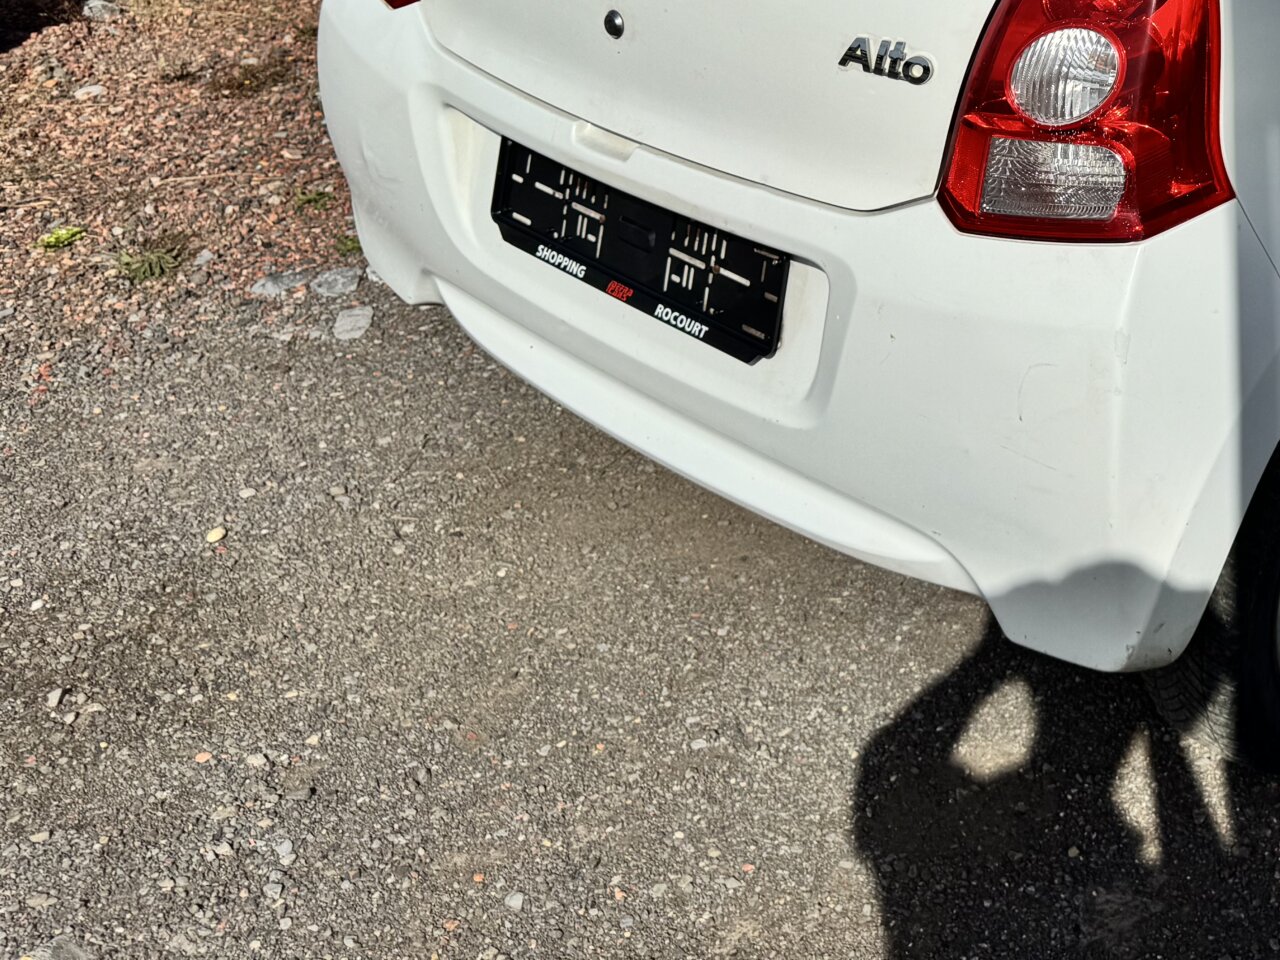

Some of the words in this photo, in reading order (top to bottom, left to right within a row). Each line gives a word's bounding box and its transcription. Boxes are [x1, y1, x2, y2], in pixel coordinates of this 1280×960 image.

[838, 37, 934, 85] Alto
[536, 244, 587, 279] SHOPPING
[654, 303, 709, 338] ROCOURT
